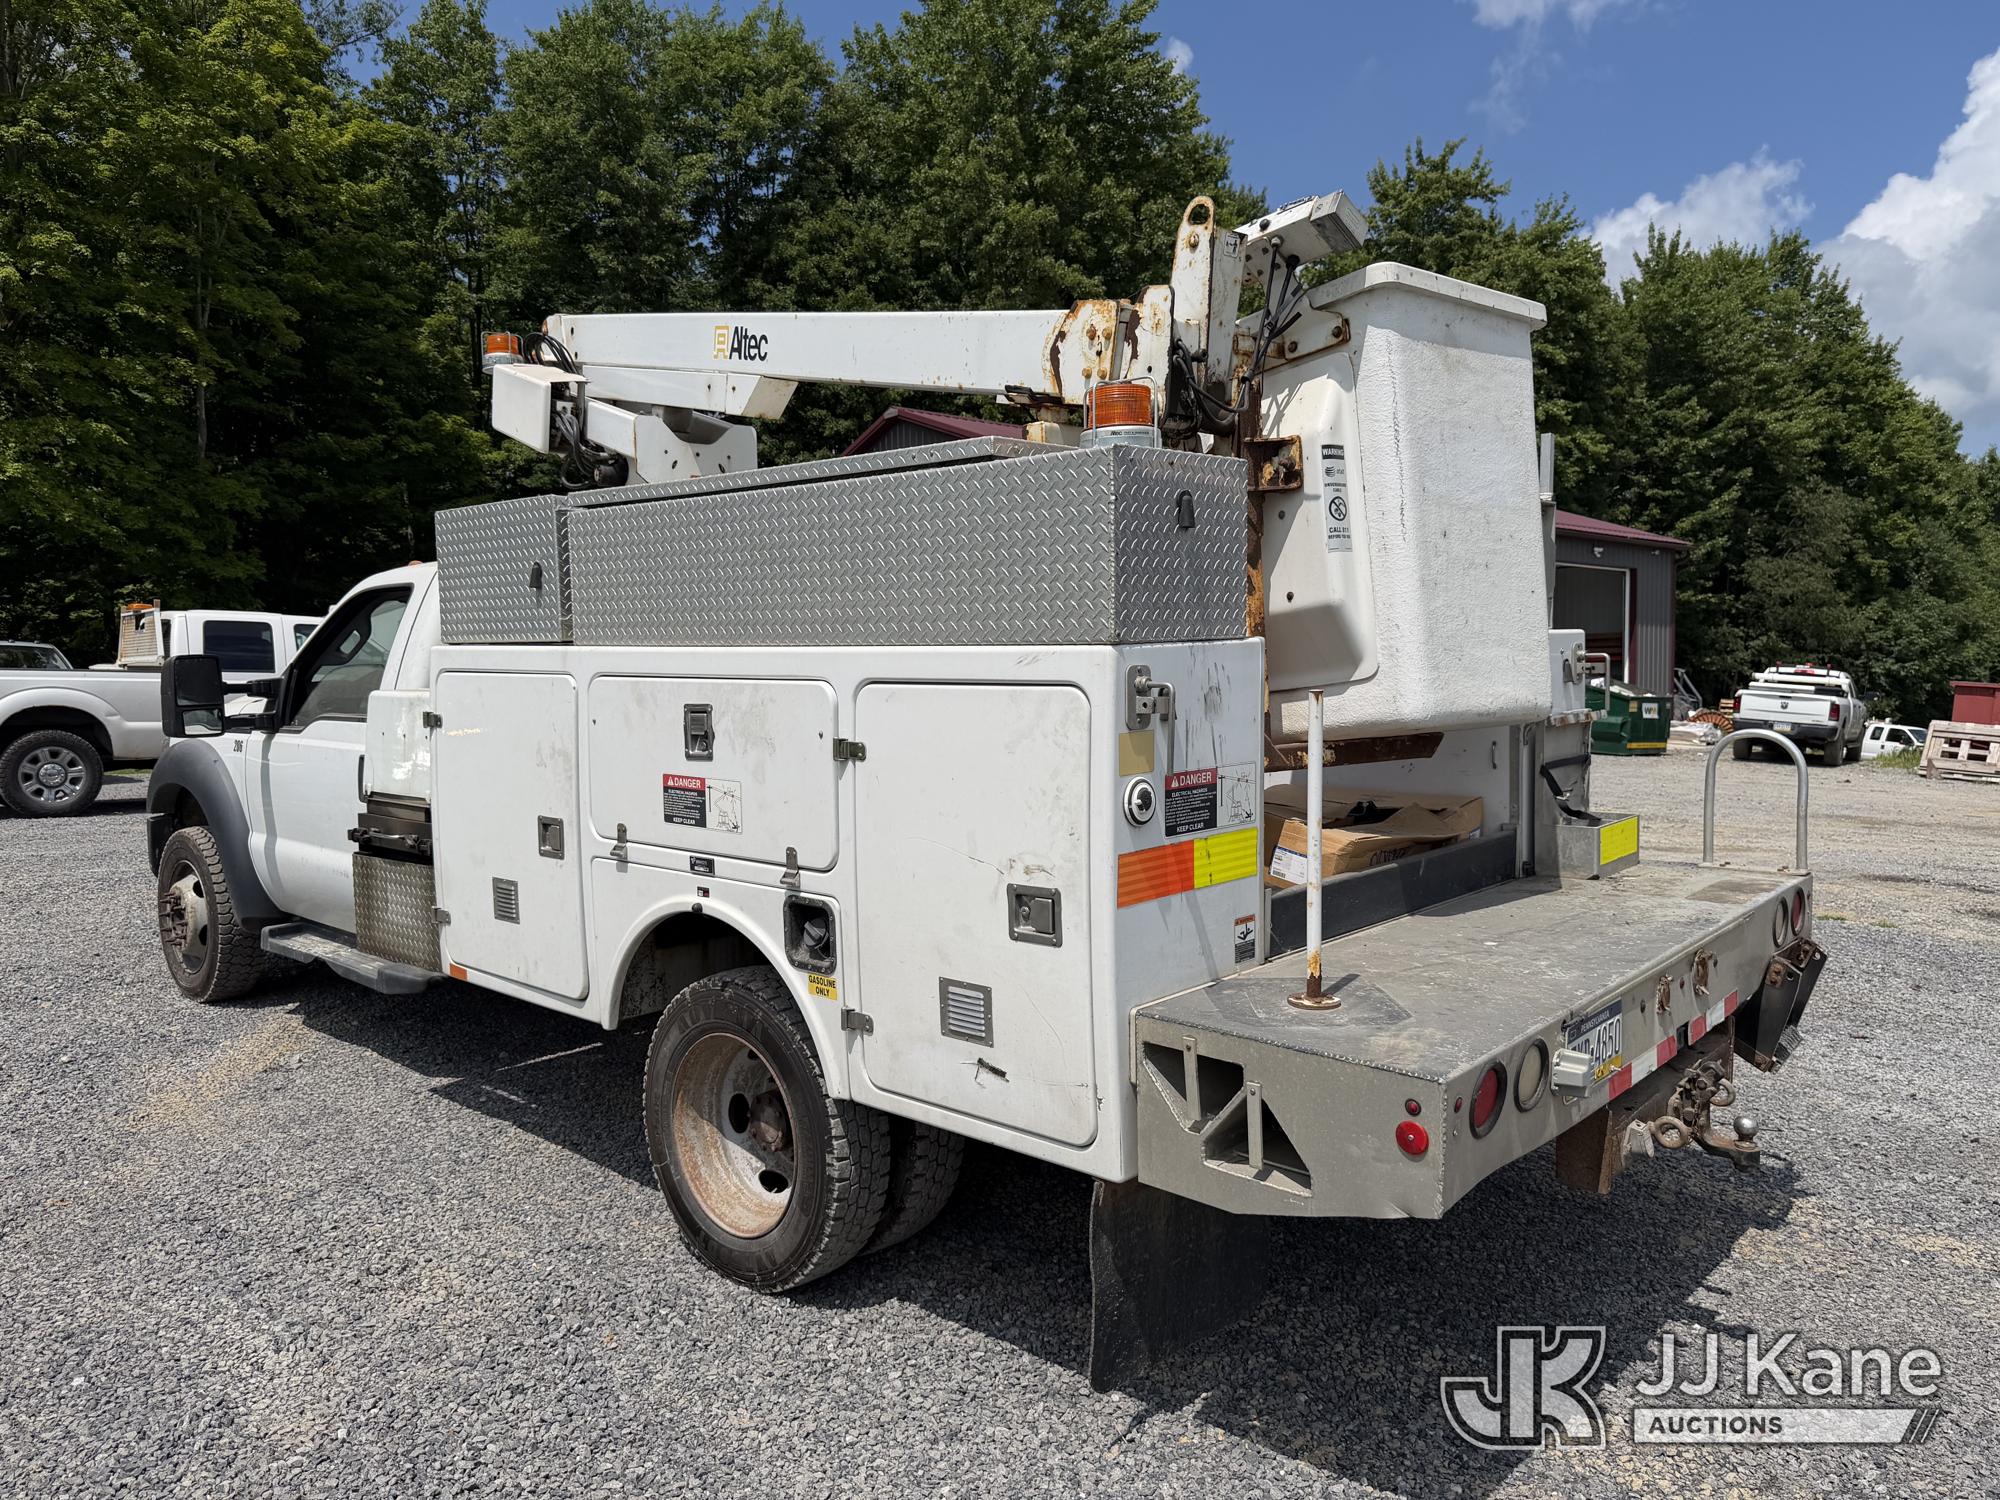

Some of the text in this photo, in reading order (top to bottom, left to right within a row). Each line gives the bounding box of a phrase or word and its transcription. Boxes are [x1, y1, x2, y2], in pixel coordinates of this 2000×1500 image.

[729, 326, 768, 361] Altec
[674, 777, 701, 789] DANGER
[1180, 772, 1212, 786] DANGER
[1189, 822, 1204, 830] CLEAR
[808, 974, 836, 989] GASOLINE
[815, 986, 830, 997] ONLY
[1580, 1010, 1610, 1033] PENNSYLVANIA
